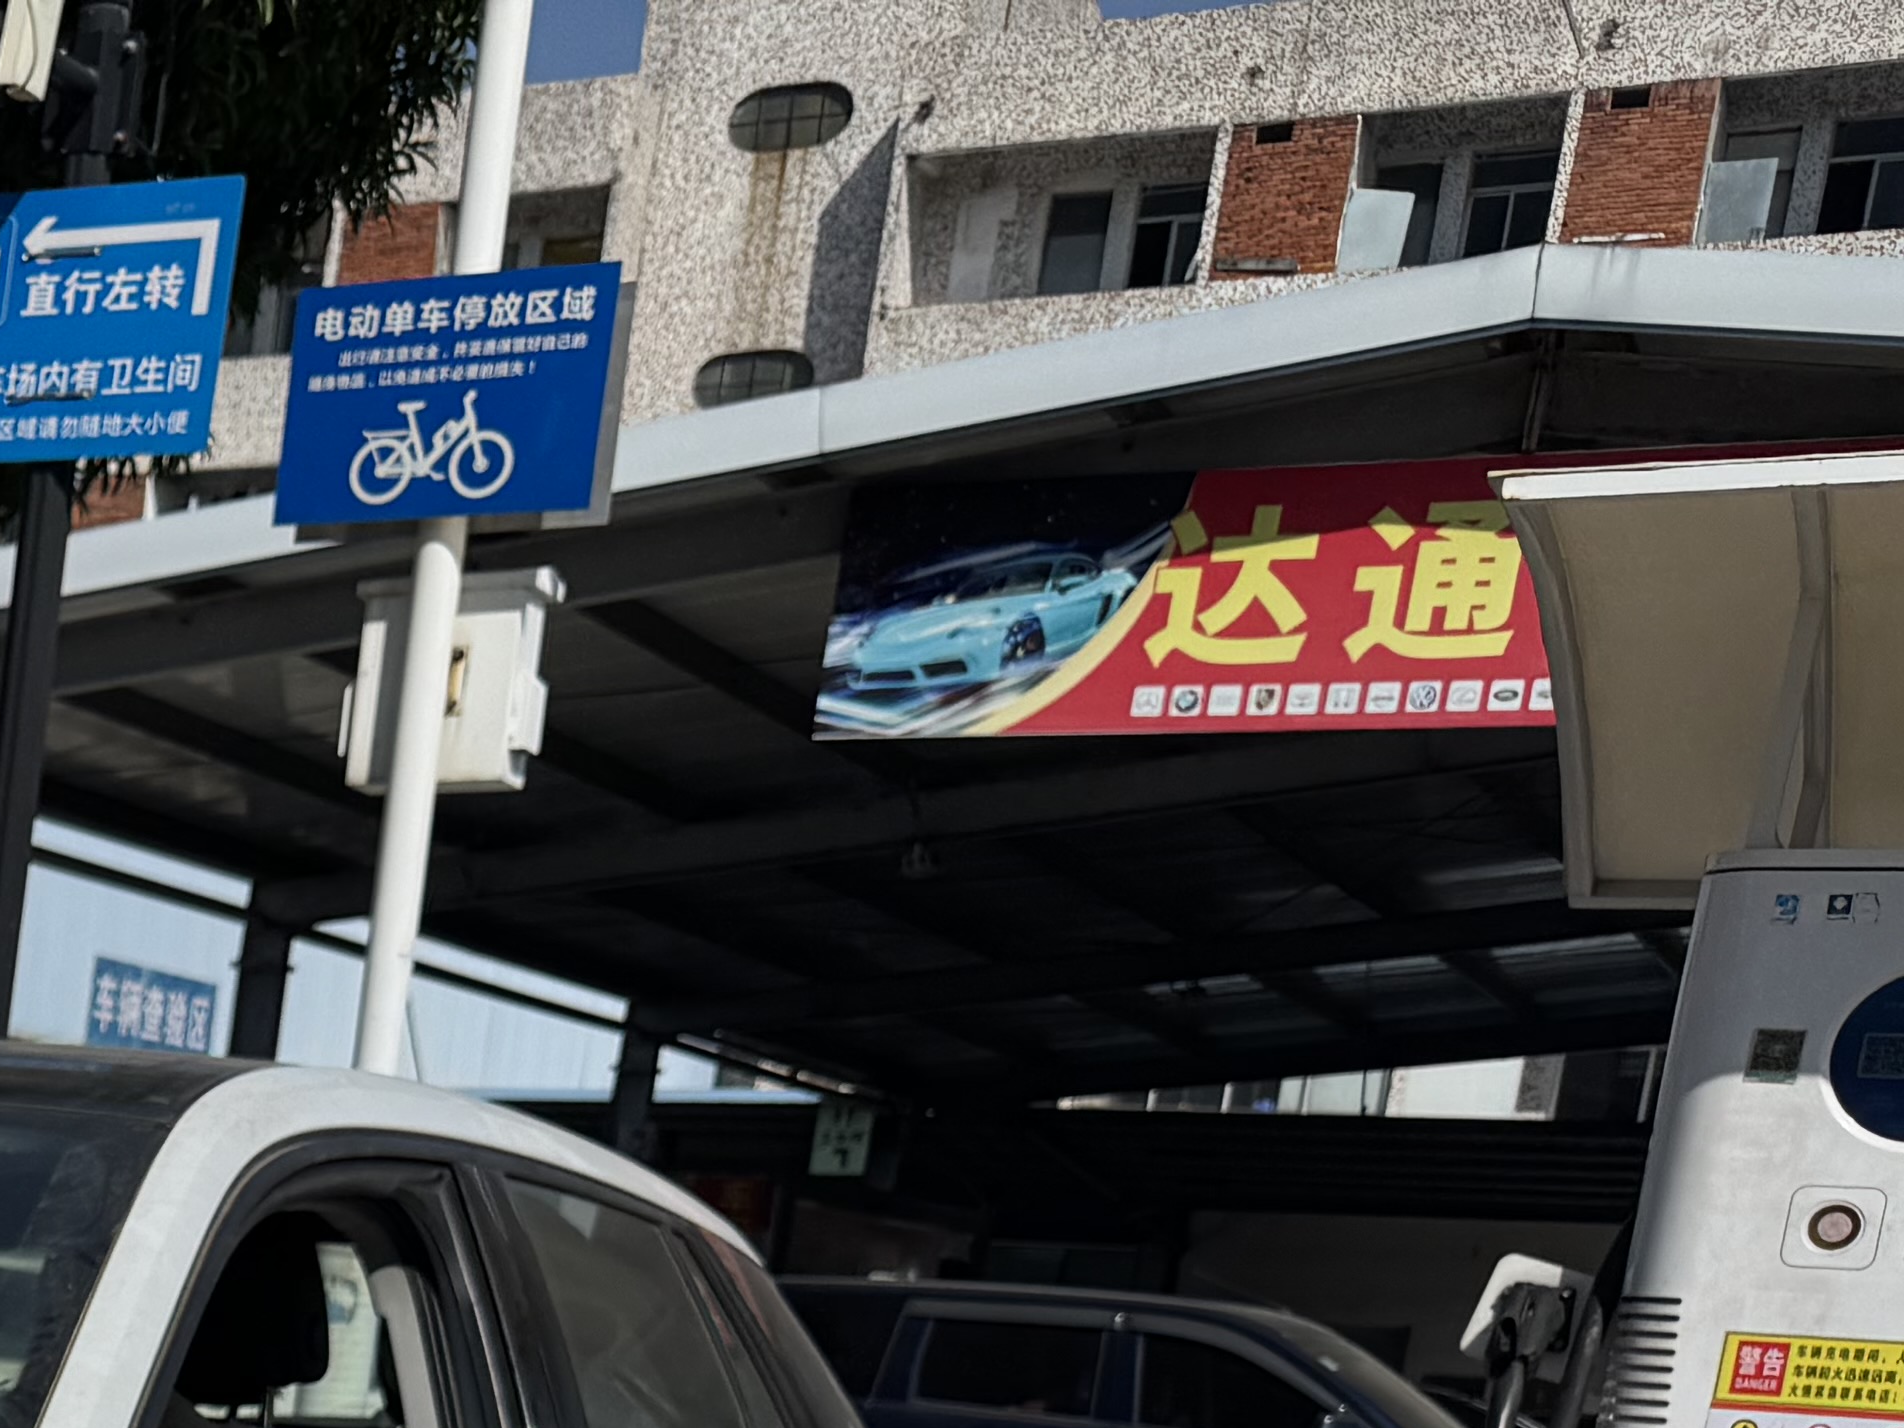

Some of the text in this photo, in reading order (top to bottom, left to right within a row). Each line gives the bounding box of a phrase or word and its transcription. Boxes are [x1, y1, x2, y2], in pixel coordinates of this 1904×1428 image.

[20, 262, 186, 318] 直行左转
[314, 285, 597, 342] 电动单车停放区域
[1143, 500, 1524, 669] 达通
[1734, 1376, 1778, 1392] DANGER
[1739, 1345, 1785, 1377] 警告
